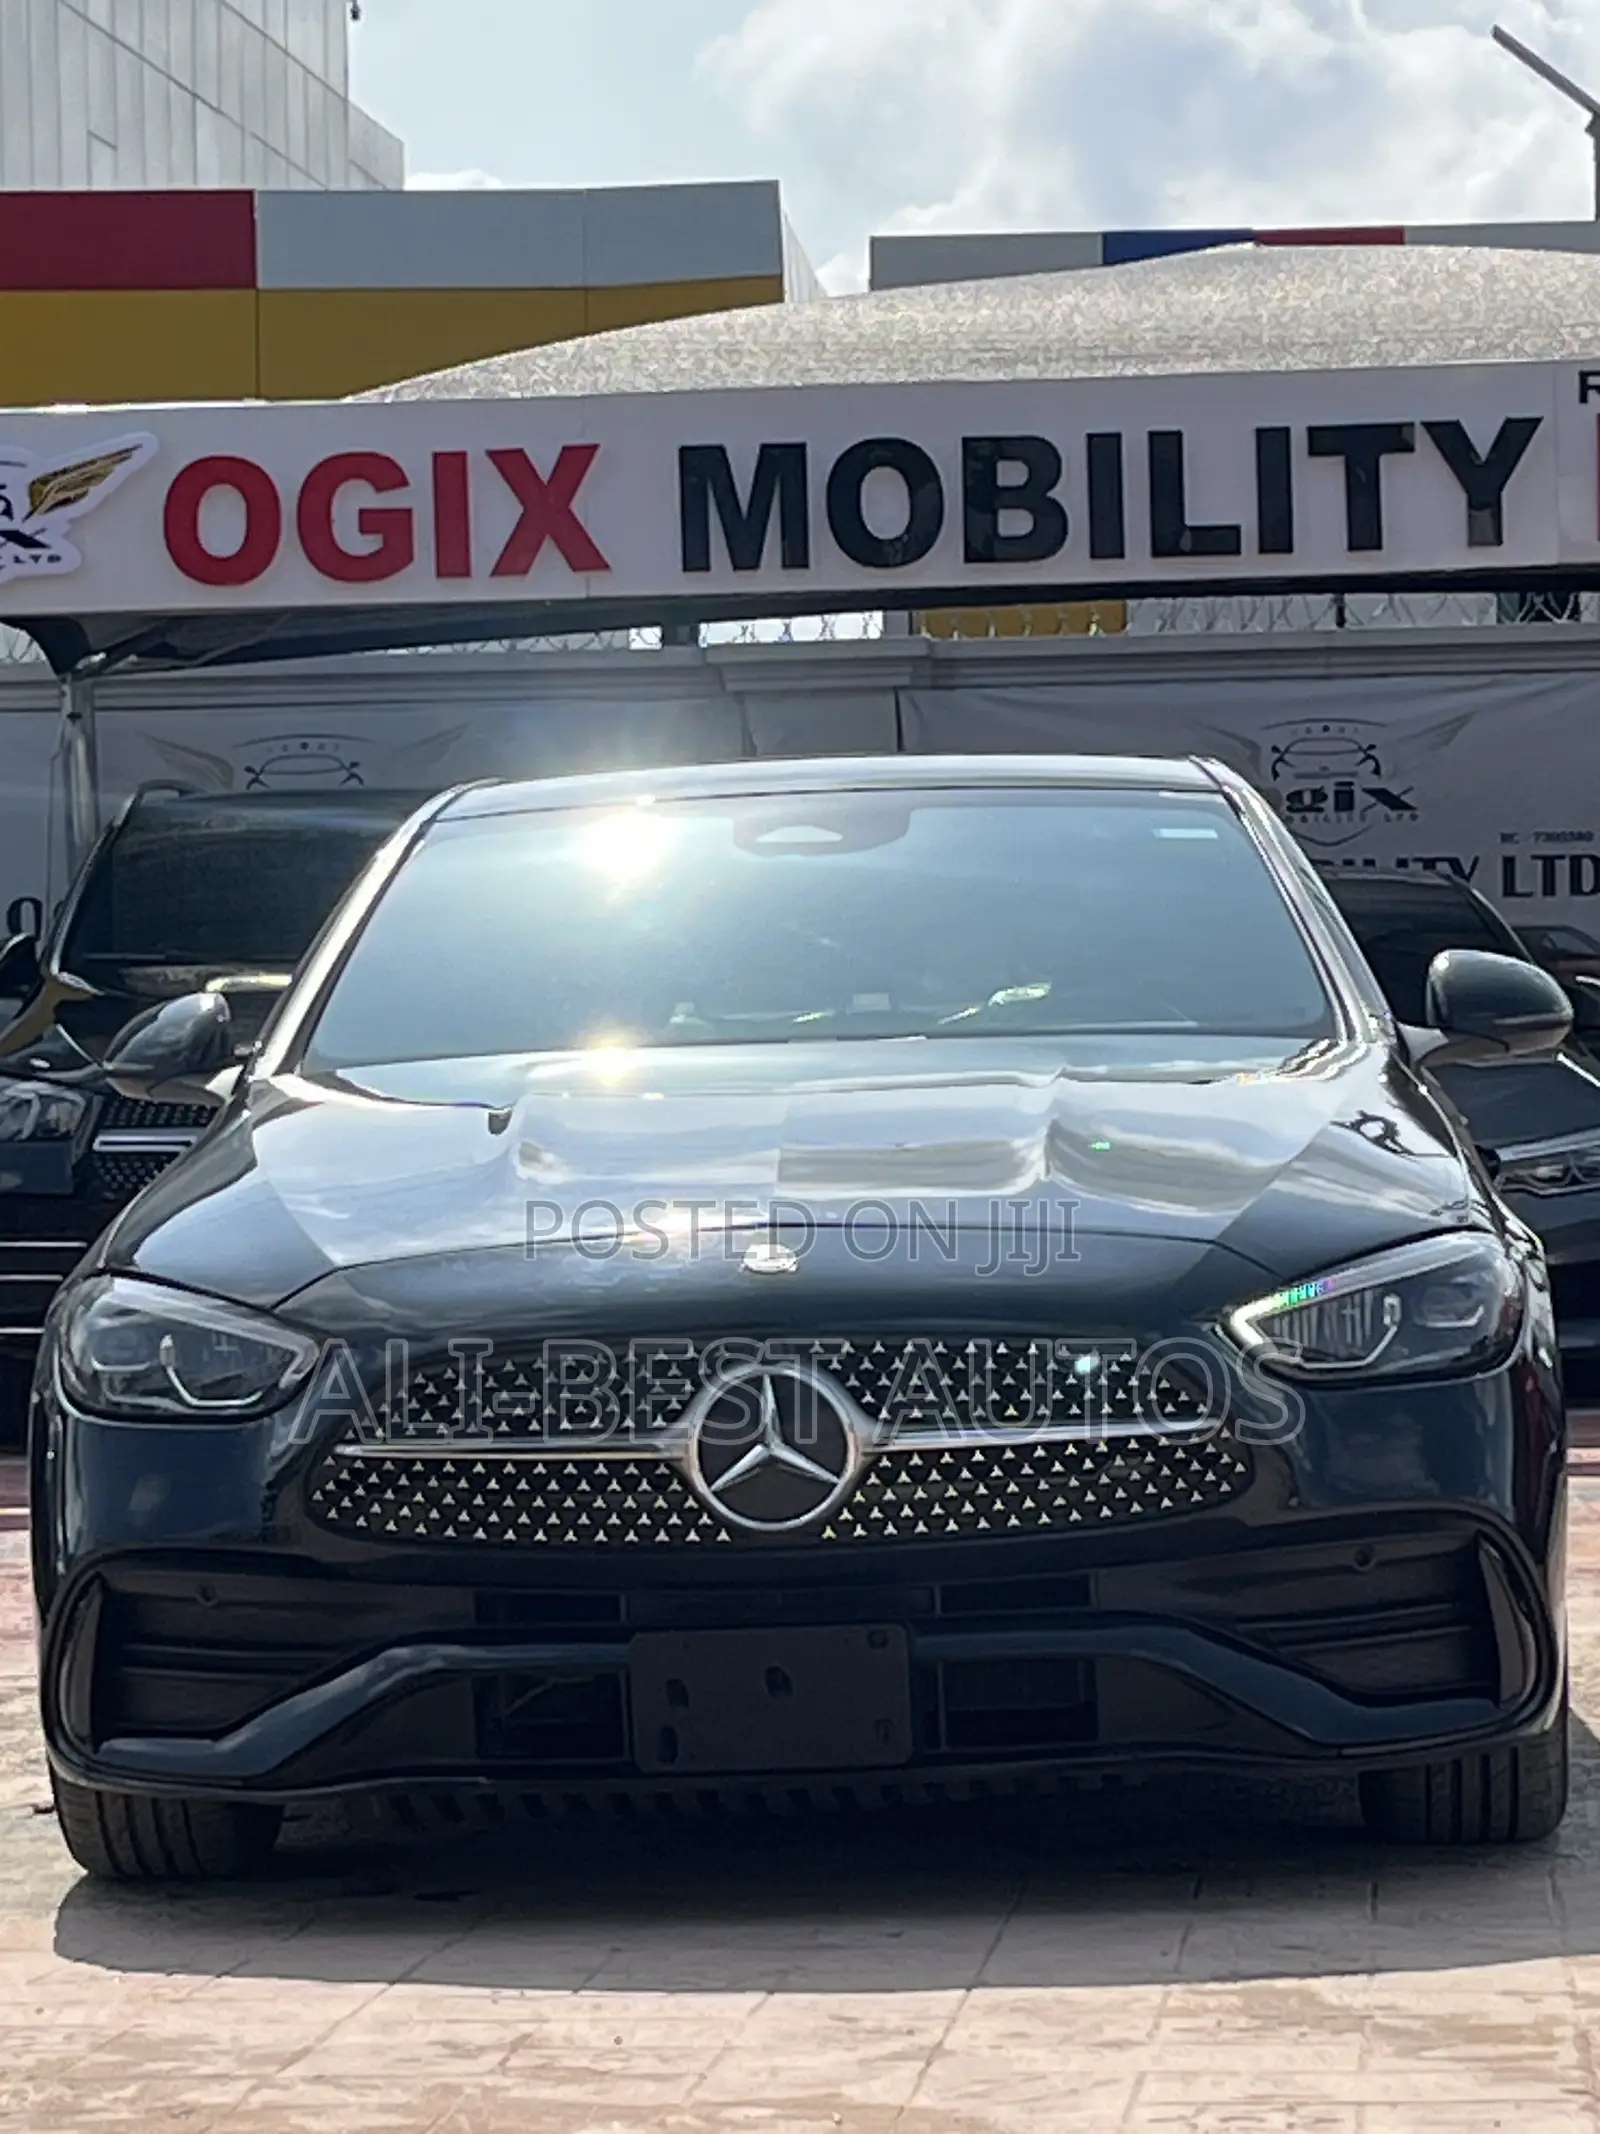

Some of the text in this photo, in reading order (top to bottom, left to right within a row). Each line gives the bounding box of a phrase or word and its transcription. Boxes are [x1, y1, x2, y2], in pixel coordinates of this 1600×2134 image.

[162, 444, 611, 586] OGIX
[678, 416, 1544, 572] MOBILITY
[1502, 853, 1600, 898] LTD
